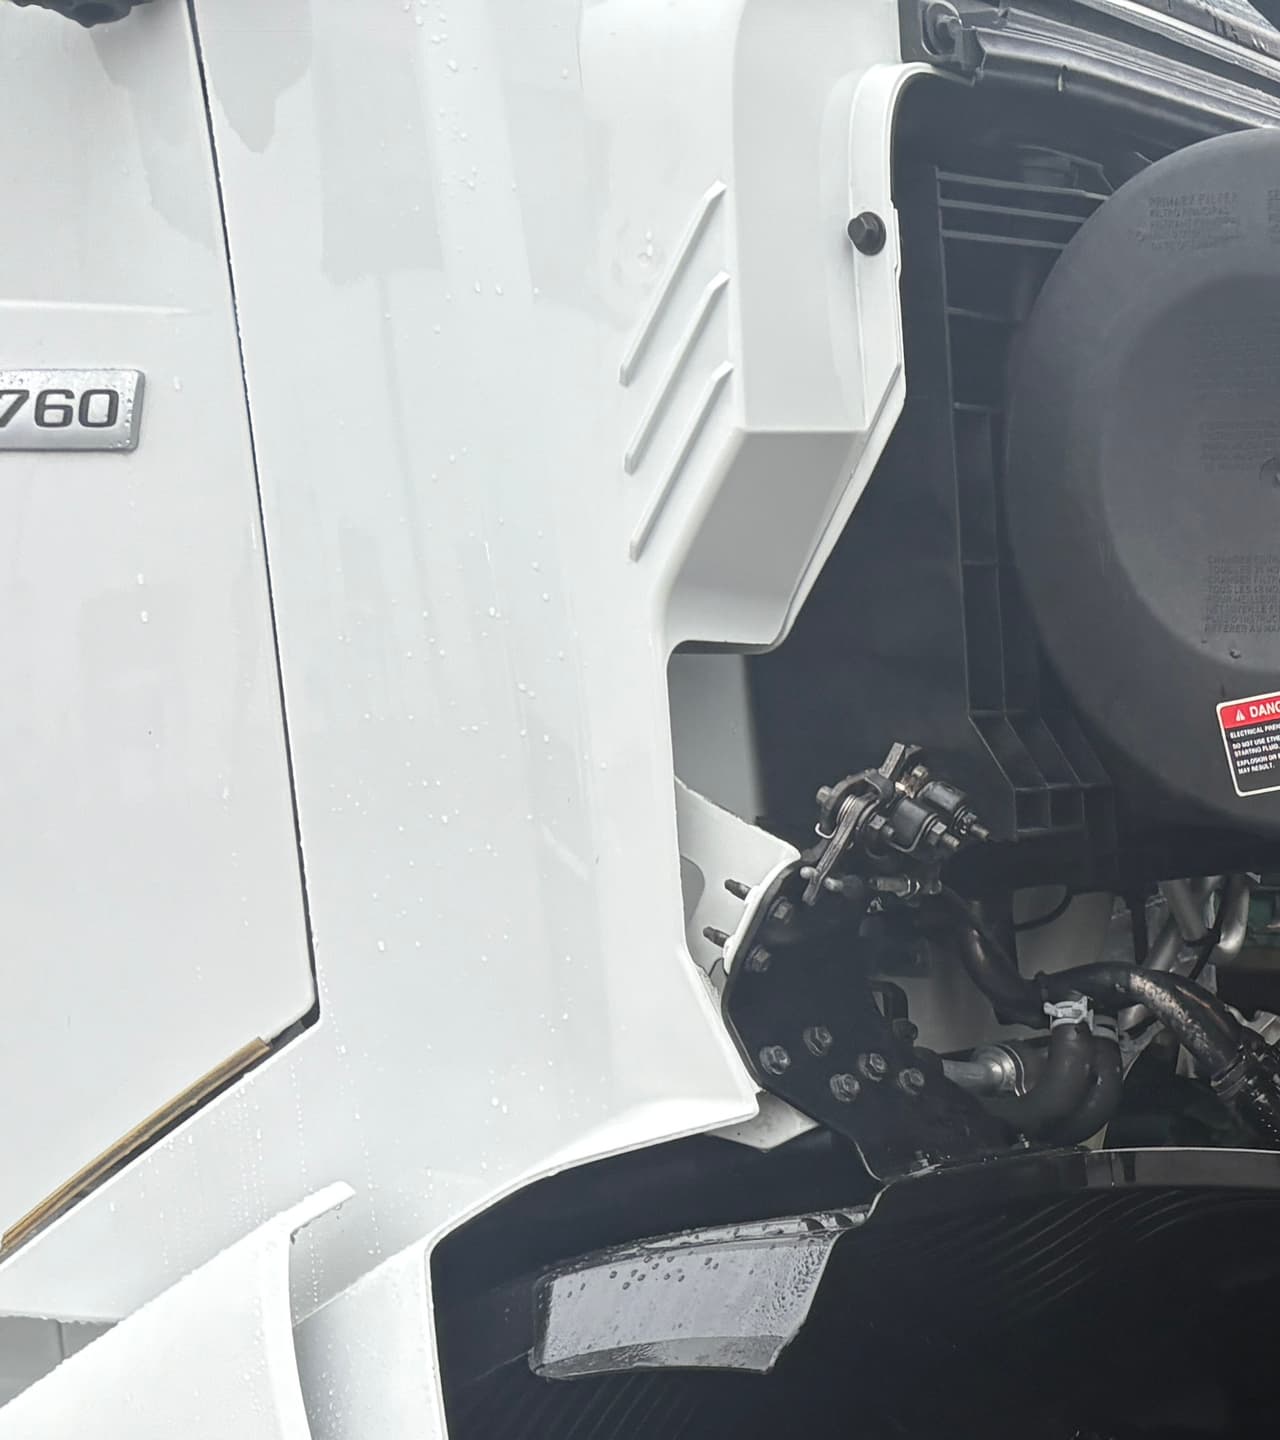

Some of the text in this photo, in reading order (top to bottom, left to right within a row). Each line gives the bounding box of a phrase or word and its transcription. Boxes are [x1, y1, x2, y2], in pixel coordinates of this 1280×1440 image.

[1230, 726, 1265, 739] ELECTRICAL
[1232, 742, 1241, 750] DO
[1241, 738, 1254, 748] NOT
[1254, 736, 1266, 747] USE
[1234, 747, 1262, 758] STARTING
[1236, 755, 1269, 768] EXPLOSION
[1268, 753, 1277, 762] OR
[1238, 766, 1251, 774] MAY
